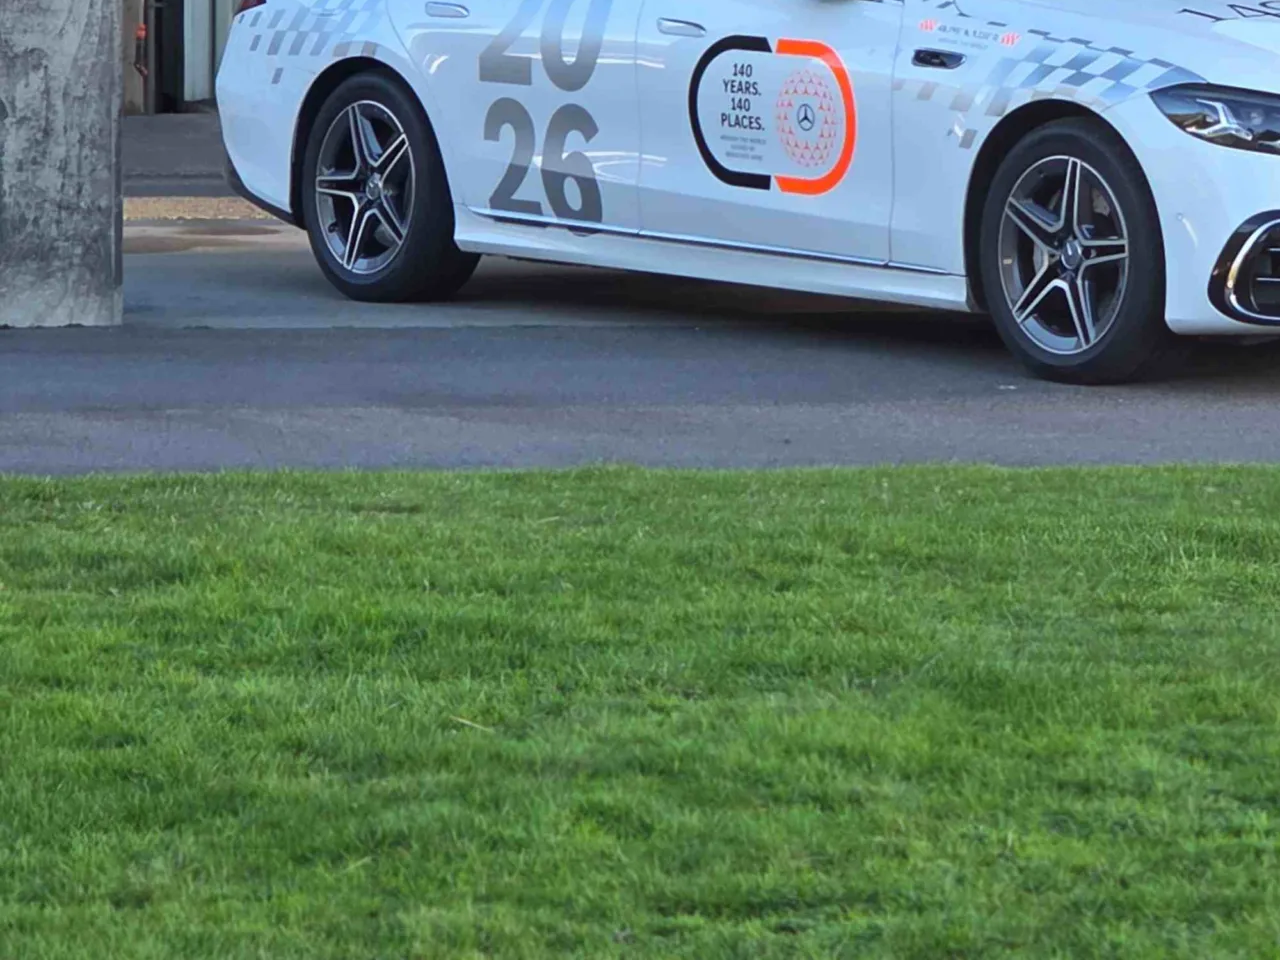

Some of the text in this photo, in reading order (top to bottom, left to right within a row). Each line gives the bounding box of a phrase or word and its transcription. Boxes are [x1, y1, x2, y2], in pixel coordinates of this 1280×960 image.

[732, 63, 753, 77] 140
[722, 78, 762, 96] YEARS.
[731, 97, 751, 112] 140
[720, 113, 765, 131] PLACES.
[484, 97, 603, 223] 26
